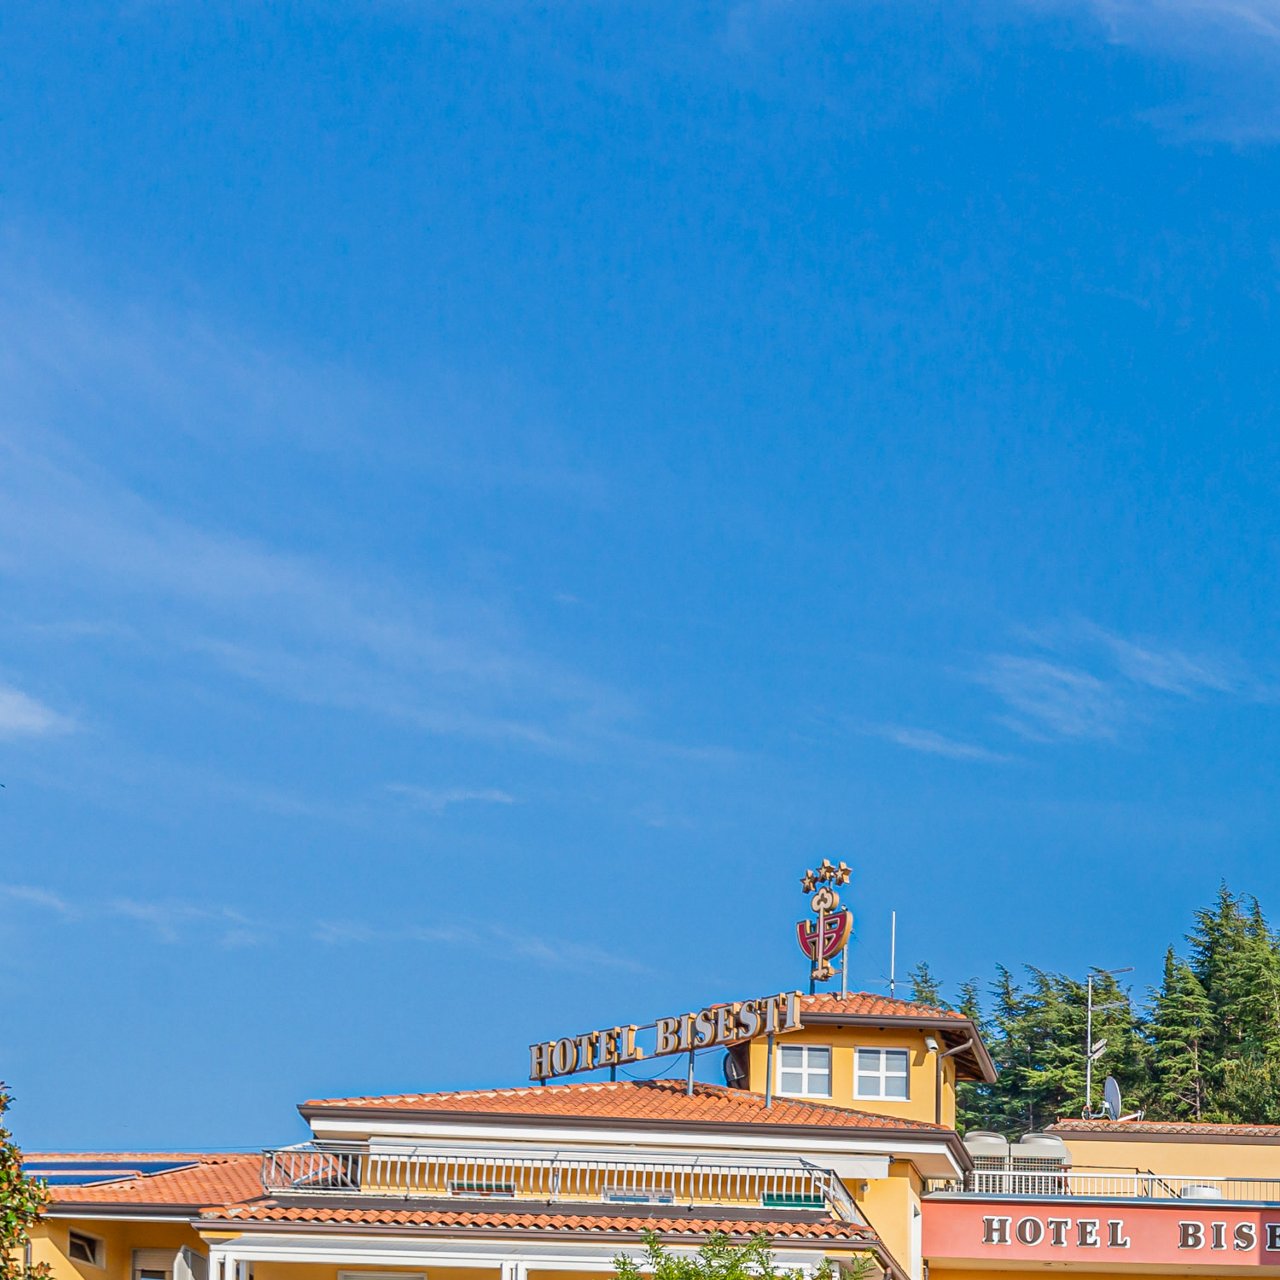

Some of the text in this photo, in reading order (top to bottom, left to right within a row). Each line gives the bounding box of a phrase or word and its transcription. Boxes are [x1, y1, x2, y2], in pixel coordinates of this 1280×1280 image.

[529, 991, 803, 1080] HOTEL BISESTI
[982, 1216, 1130, 1248] HOTEL
